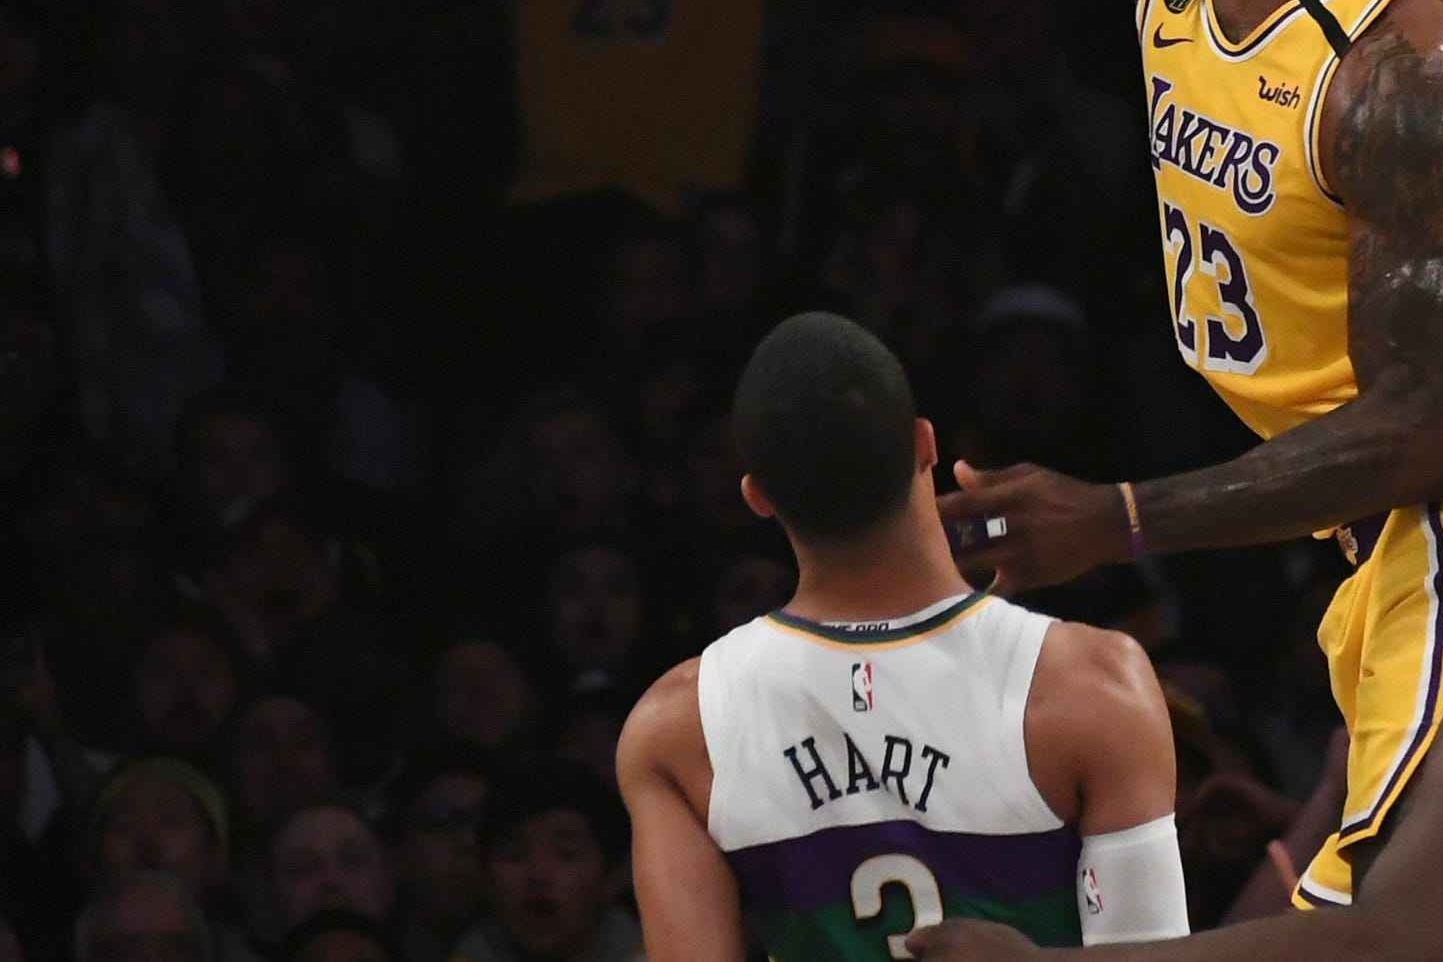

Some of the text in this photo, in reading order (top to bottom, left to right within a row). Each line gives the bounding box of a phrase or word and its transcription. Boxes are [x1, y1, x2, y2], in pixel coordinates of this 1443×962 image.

[1258, 75, 1301, 110] wish
[1162, 201, 1268, 375] 23
[783, 732, 950, 813] HART
